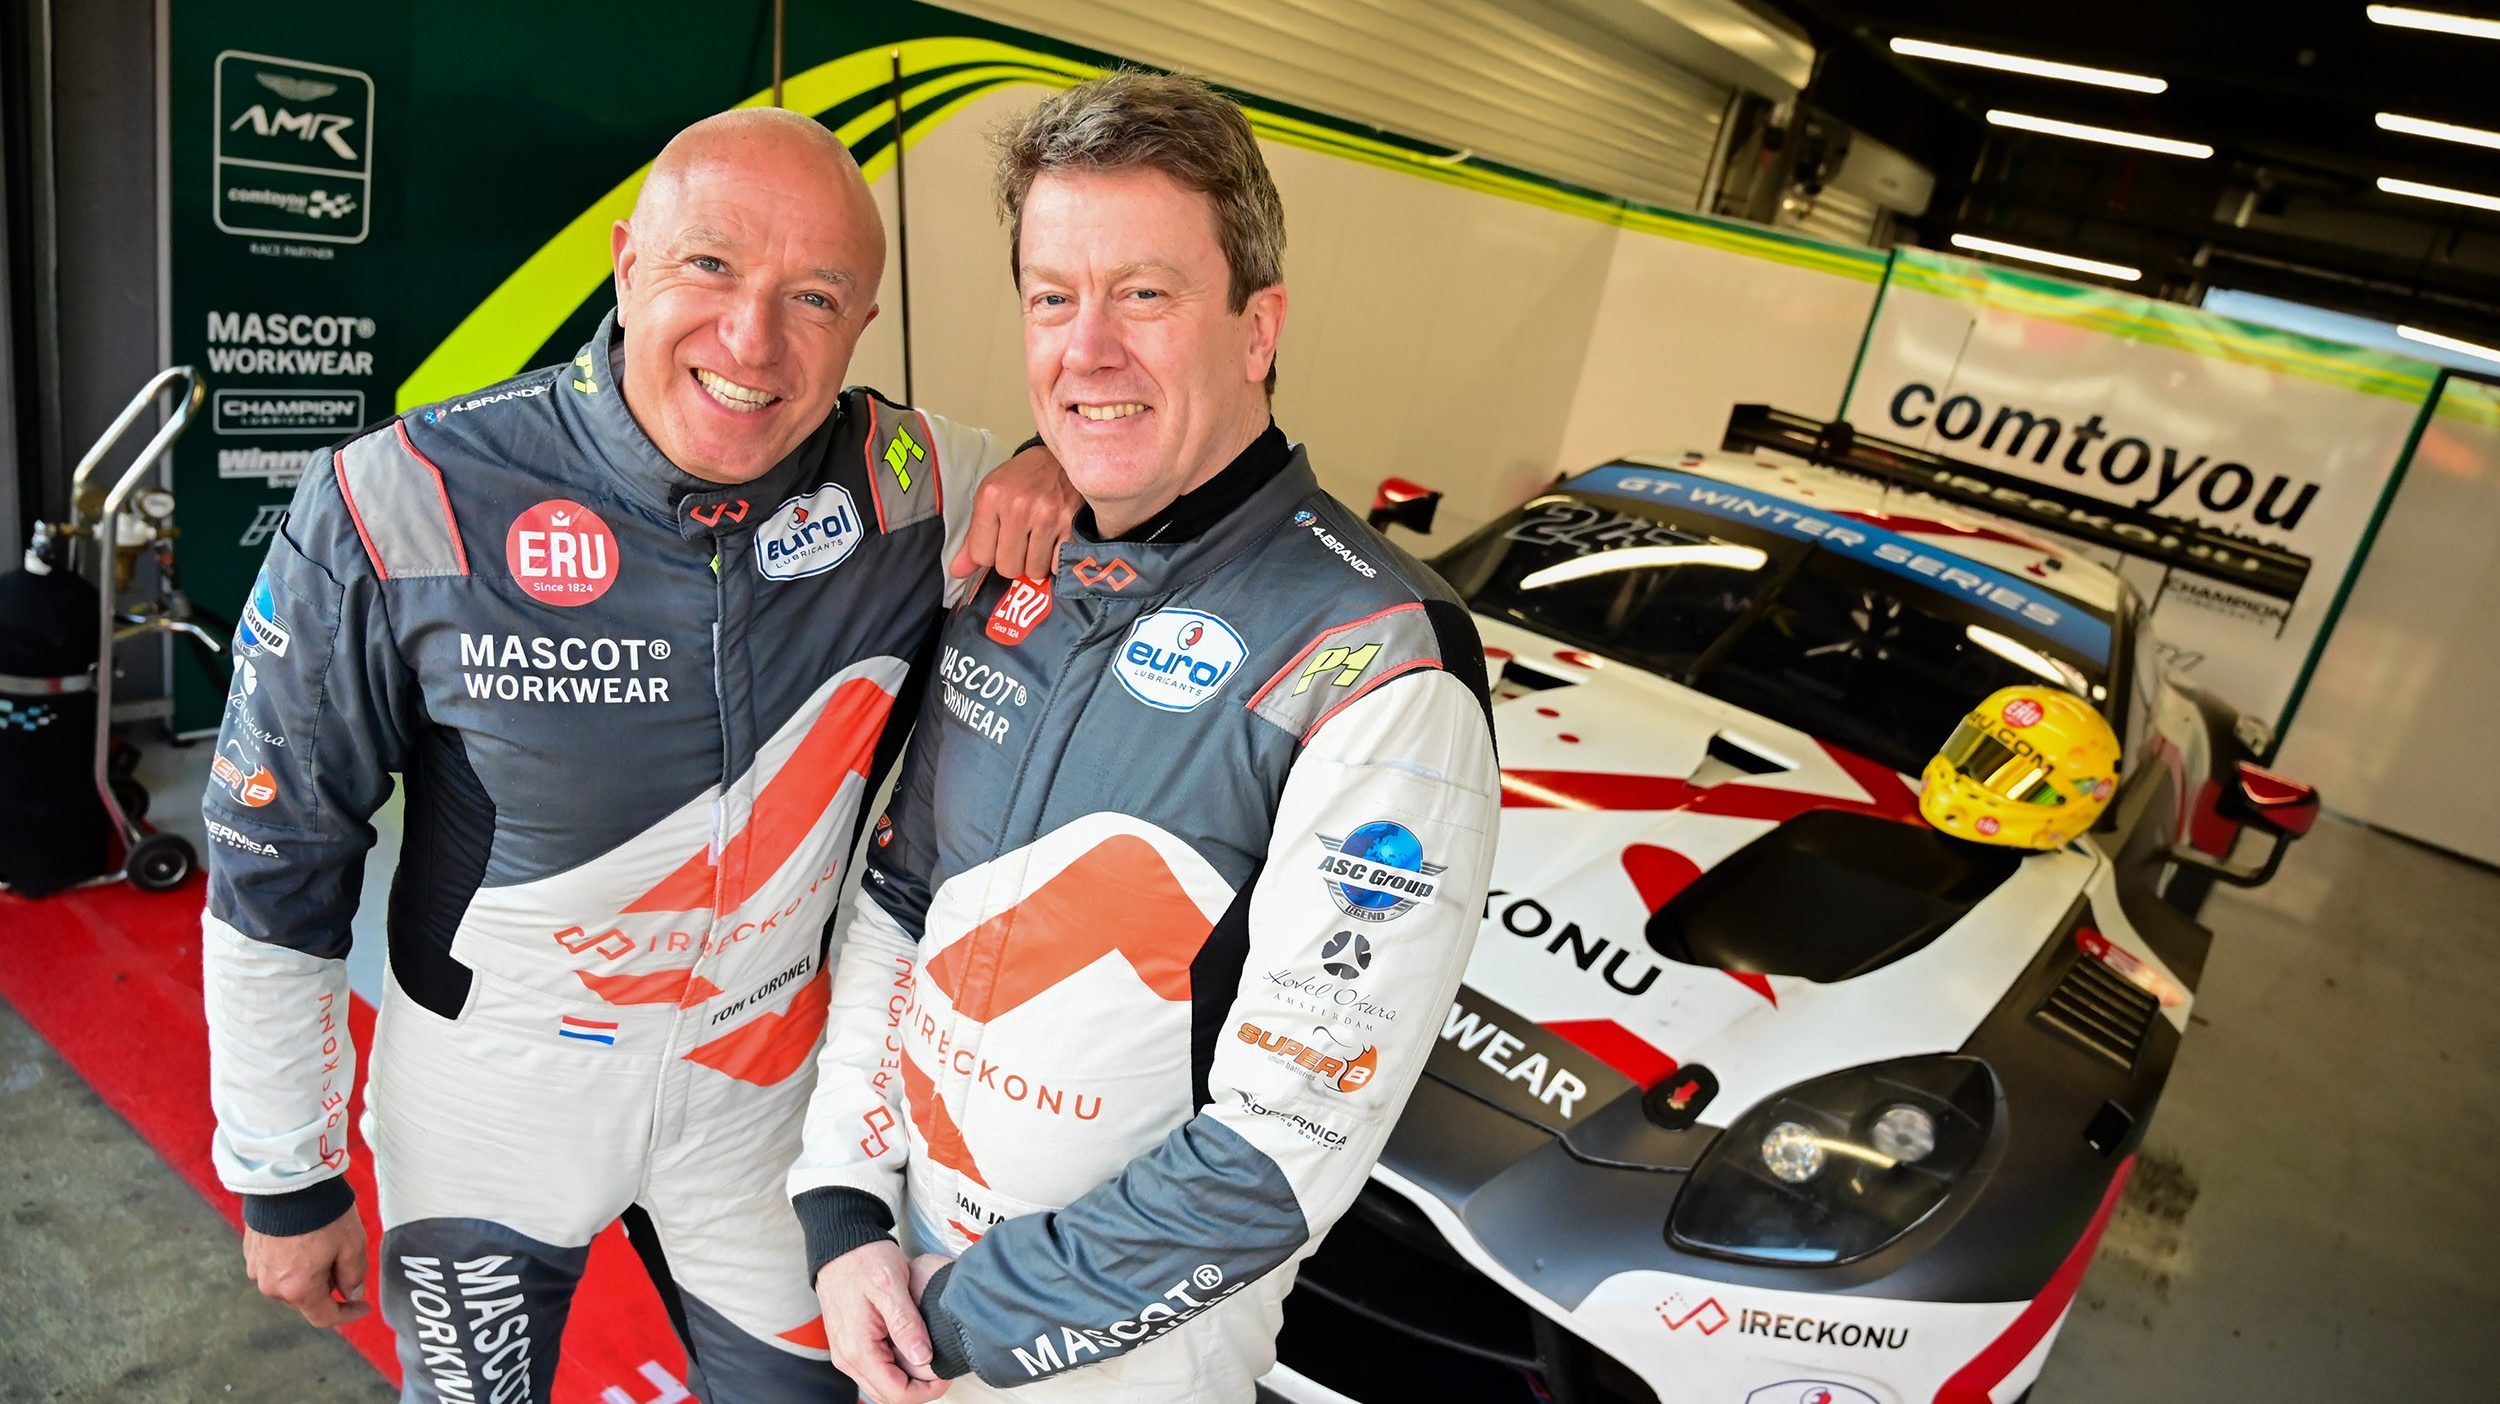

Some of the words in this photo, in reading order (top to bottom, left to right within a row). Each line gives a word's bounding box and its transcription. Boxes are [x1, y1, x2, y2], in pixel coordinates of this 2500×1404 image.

[230, 104, 358, 160] AMR
[207, 347, 374, 375] WORKWEAR
[223, 400, 355, 416] CHAMPION
[1889, 382, 2322, 531] comtoyou
[767, 504, 853, 561] eurol
[1933, 470, 2260, 572] IRECKO
[519, 530, 608, 580] ERU
[775, 538, 844, 569] LUBRICANTS
[1617, 476, 1683, 495] GT
[1690, 486, 1866, 549] WINTER
[1872, 540, 2062, 628] SERIES
[534, 582, 563, 592] Since
[567, 582, 593, 593] 1824
[247, 607, 283, 648] Group
[1126, 640, 1232, 689] eurol
[1134, 668, 1203, 697] LUBRICANTS
[1291, 643, 1383, 697] P1
[463, 672, 670, 704] WORKWEAR
[247, 784, 273, 801] B
[1317, 855, 1366, 881] ASC
[1368, 867, 1435, 898] Group
[1344, 904, 1386, 921] LEGEND
[711, 998, 746, 1025] TOM
[749, 954, 812, 1005] CORONEL
[1334, 988, 1398, 1022] Okura
[1273, 992, 1375, 1032] AMSTERDAM
[914, 1004, 1101, 1120] IRECKONU
[1237, 1022, 1343, 1080] SUPER
[1345, 1065, 1371, 1083] B
[1739, 1308, 1909, 1349] IRECKONU
